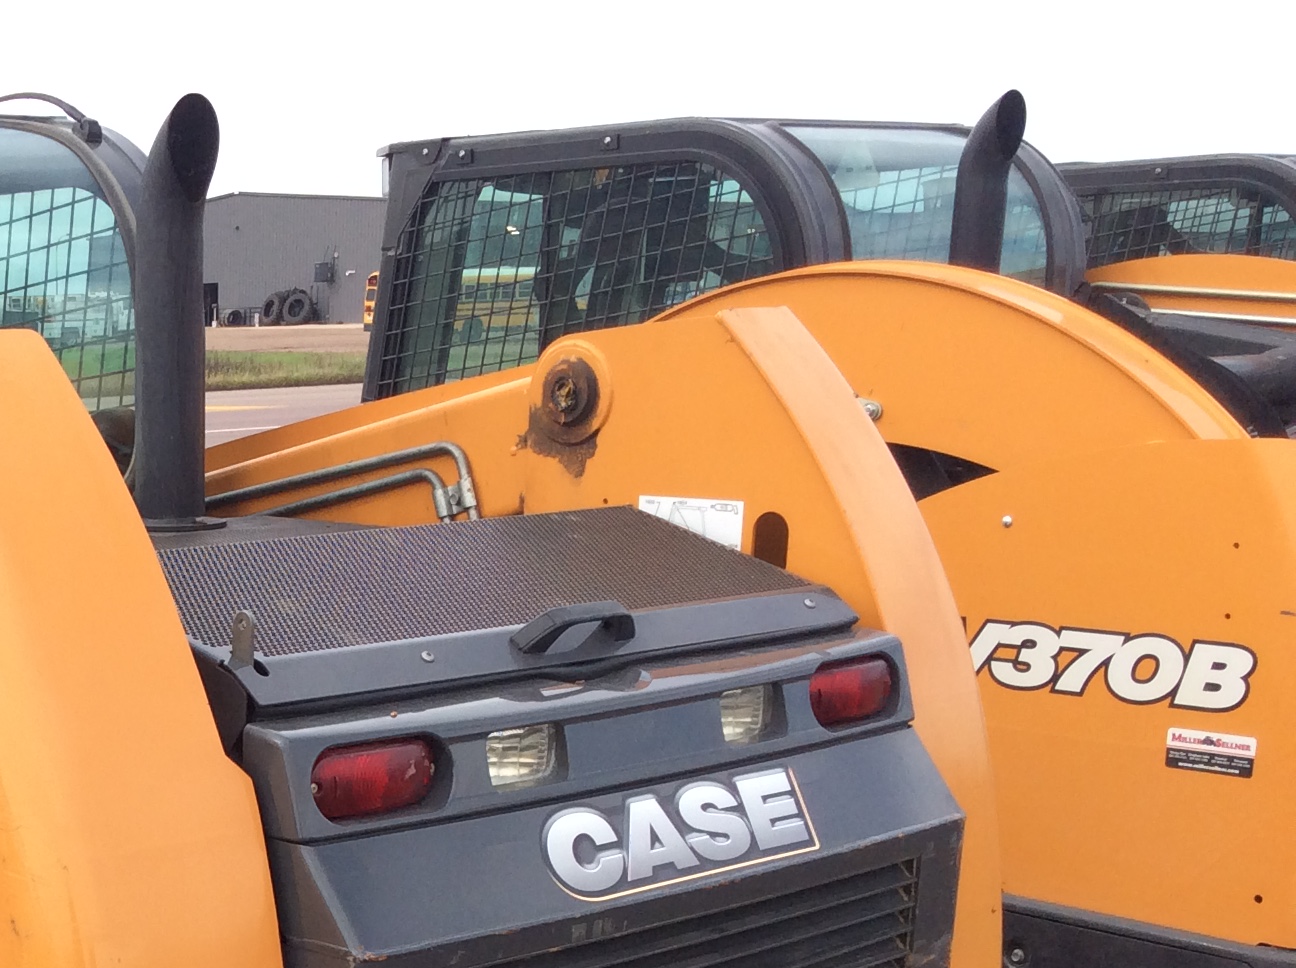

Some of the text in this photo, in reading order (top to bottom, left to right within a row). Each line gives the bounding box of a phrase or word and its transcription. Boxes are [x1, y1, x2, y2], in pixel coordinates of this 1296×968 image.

[1171, 733, 1251, 752] MILLER SELLNER
[545, 768, 812, 893] CASE
